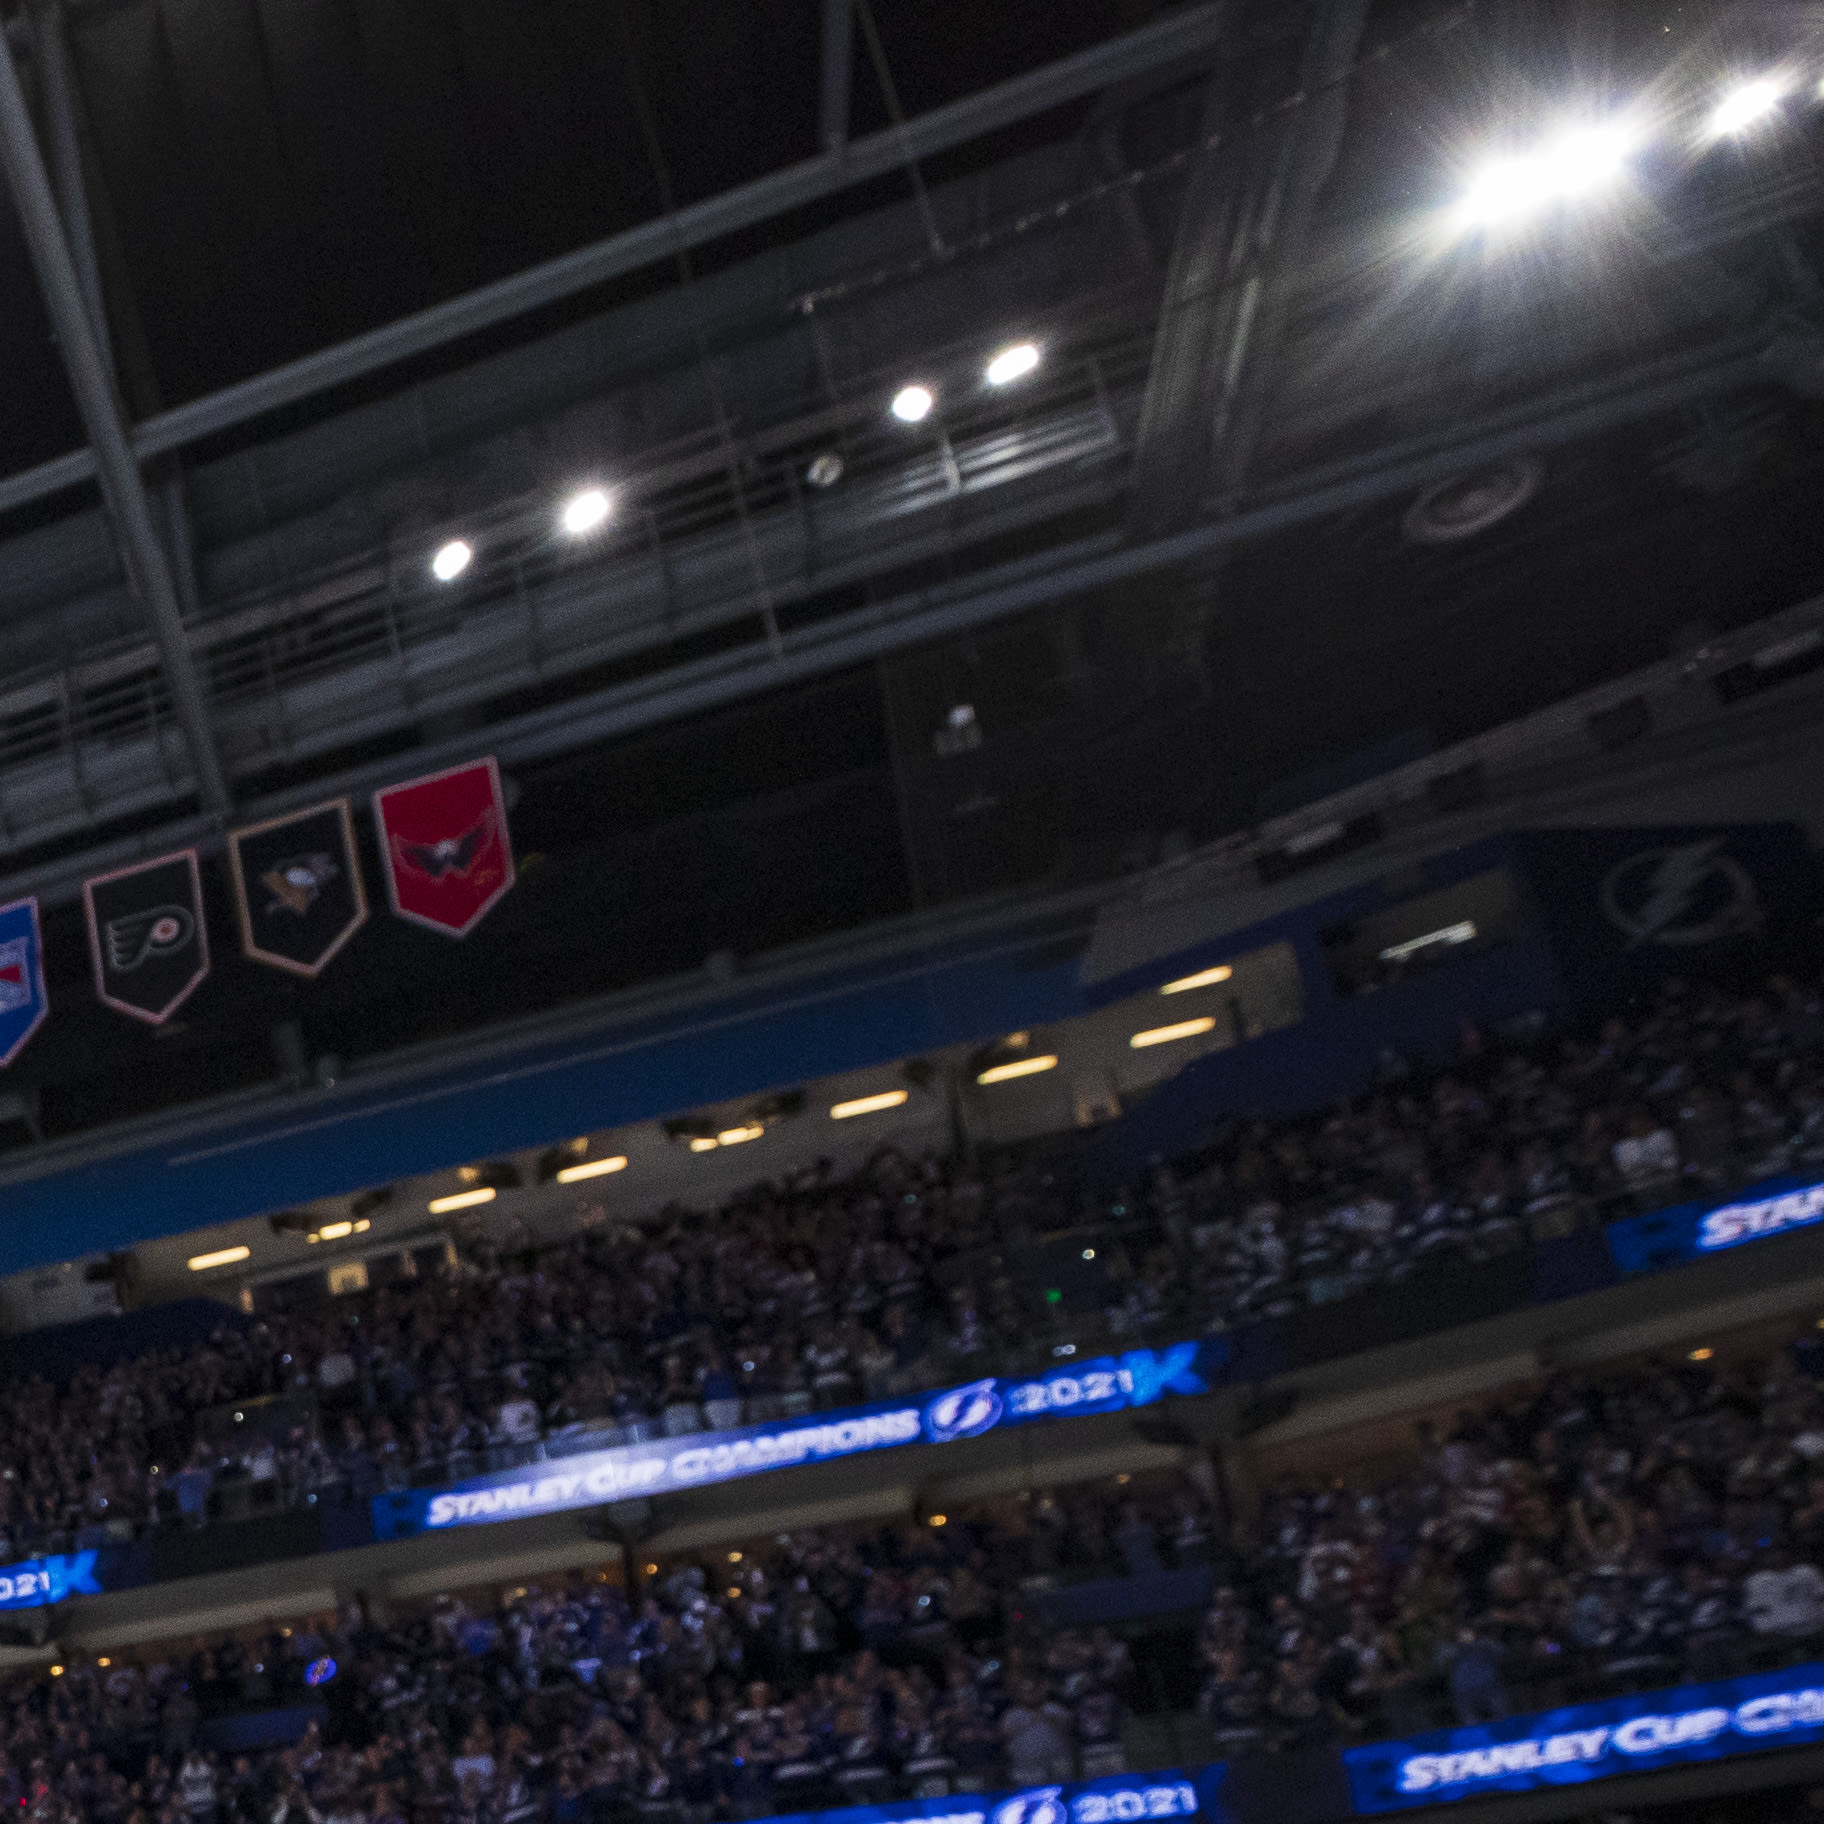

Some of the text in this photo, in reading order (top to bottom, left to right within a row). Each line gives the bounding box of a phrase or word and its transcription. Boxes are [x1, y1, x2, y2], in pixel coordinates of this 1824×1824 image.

[426, 1367, 1135, 1529] STANLEY CUP CHAMPIONS 2021
[1399, 1726, 1609, 1793] STANLEY
[1612, 1707, 1730, 1755] CUP
